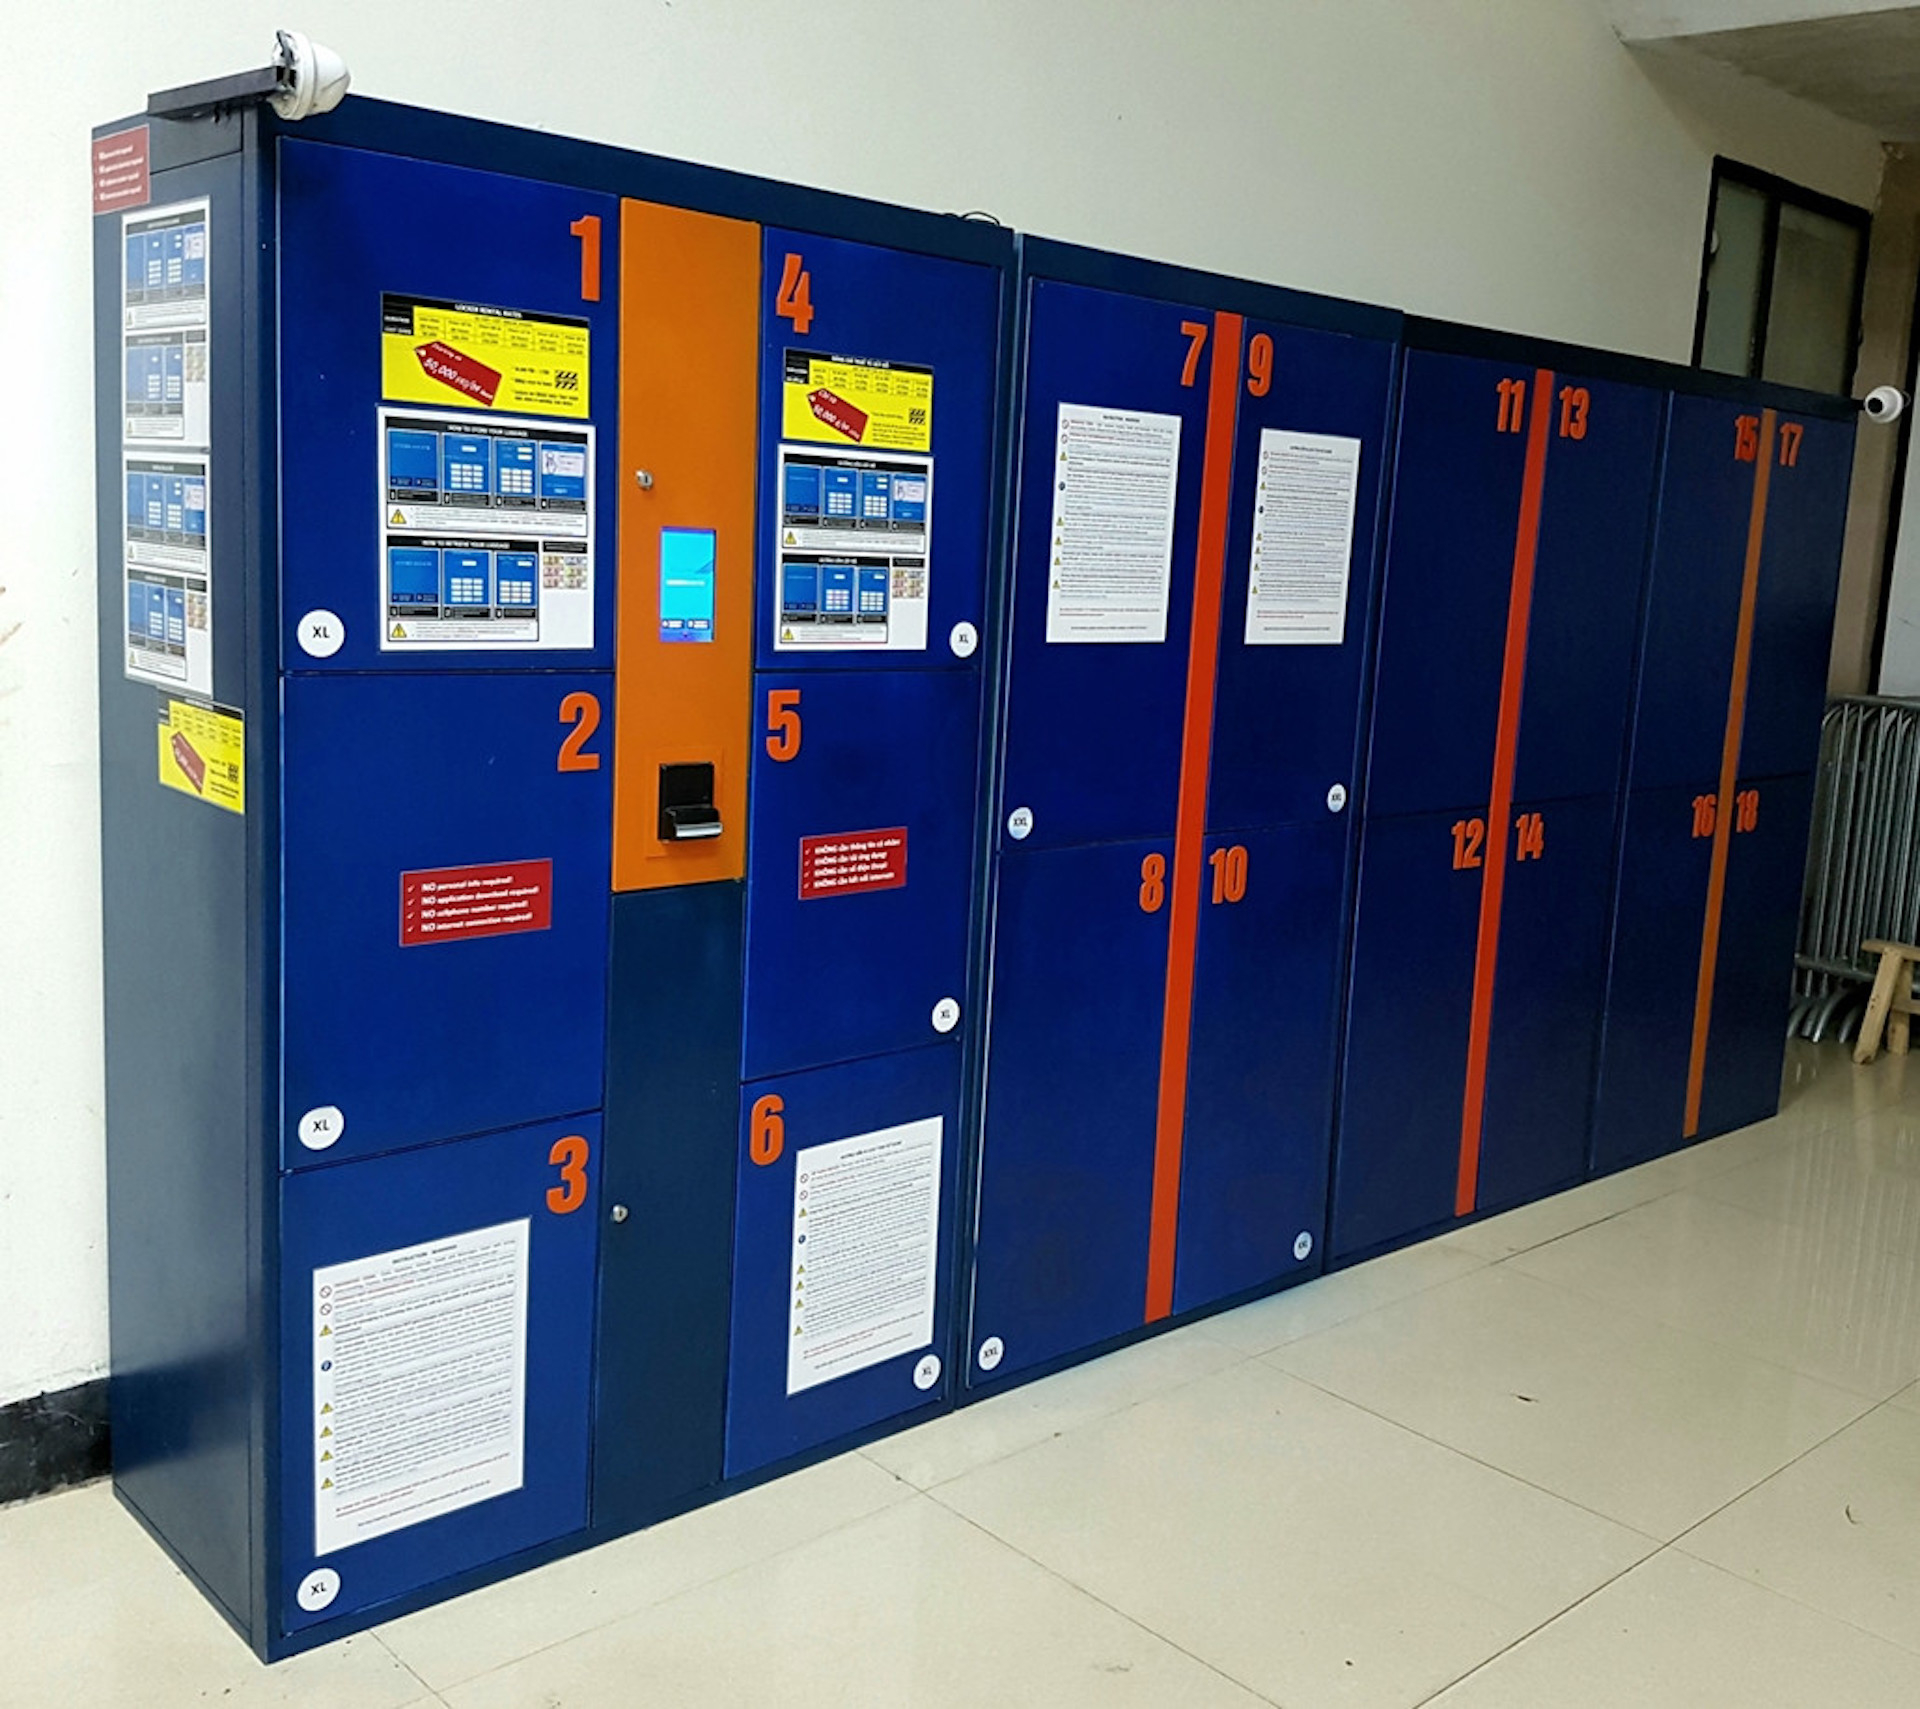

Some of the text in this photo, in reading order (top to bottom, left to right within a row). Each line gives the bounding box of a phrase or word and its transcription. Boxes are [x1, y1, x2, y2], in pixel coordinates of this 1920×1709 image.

[570, 215, 601, 303] 1
[479, 306, 502, 316] RENTAL
[777, 253, 813, 333] 4
[424, 357, 458, 381] 50,000
[1180, 321, 1207, 387] 7
[1247, 333, 1274, 397] 9
[1496, 378, 1525, 433] 11
[1558, 386, 1589, 440] 13
[448, 424, 463, 433] HOW
[1734, 414, 1757, 463] 15
[1778, 422, 1803, 467] 17
[422, 539, 436, 547] HOW
[313, 626, 329, 639] XL
[959, 634, 969, 644] XL
[557, 691, 601, 773] 2
[766, 689, 801, 762] 5
[1013, 817, 1027, 828] XXL
[1691, 793, 1716, 838] 16
[1735, 790, 1760, 833] 18
[1451, 817, 1485, 870] 12
[1515, 812, 1544, 863] 14
[421, 882, 436, 893] NO
[437, 880, 467, 892] personal
[467, 879, 481, 888] info
[421, 896, 436, 906] NO
[437, 893, 475, 905] application
[475, 889, 508, 900] download
[1138, 853, 1165, 913] 8
[1209, 846, 1247, 905] 10
[421, 909, 436, 919] NO
[436, 907, 470, 918] cellphone
[470, 903, 497, 914] number
[421, 922, 436, 932] NO
[436, 920, 464, 931] internet
[464, 917, 501, 928] connection
[941, 1010, 950, 1019] XL
[313, 1119, 329, 1133] XL
[750, 1095, 784, 1166] 6
[546, 1135, 589, 1215] 3
[923, 1368, 932, 1376] XL
[984, 1347, 998, 1358] XXL
[311, 1582, 326, 1596] XL
